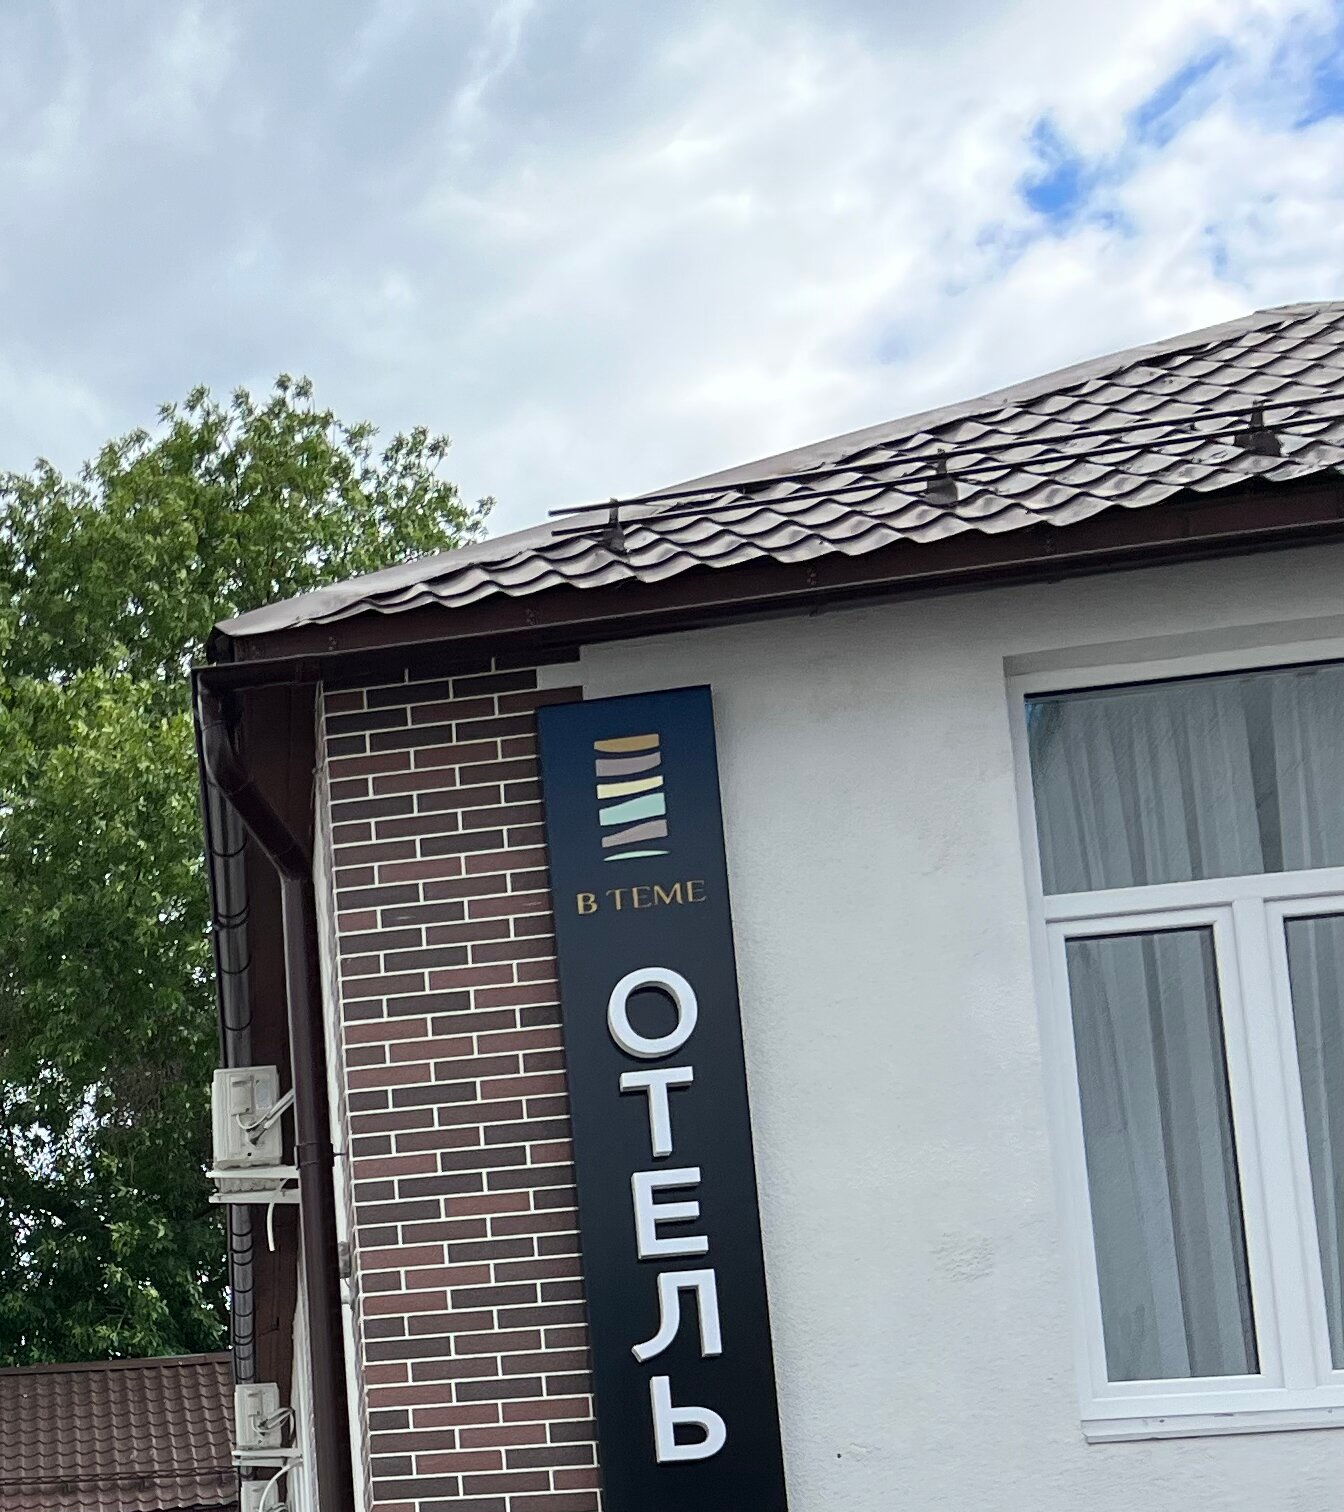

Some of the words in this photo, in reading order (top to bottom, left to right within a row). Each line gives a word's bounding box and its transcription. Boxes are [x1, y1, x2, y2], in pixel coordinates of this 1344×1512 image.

[575, 892, 599, 915] В
[605, 879, 708, 911] ТЕМЕ
[606, 966, 729, 1465] ОТЕЛЬ
